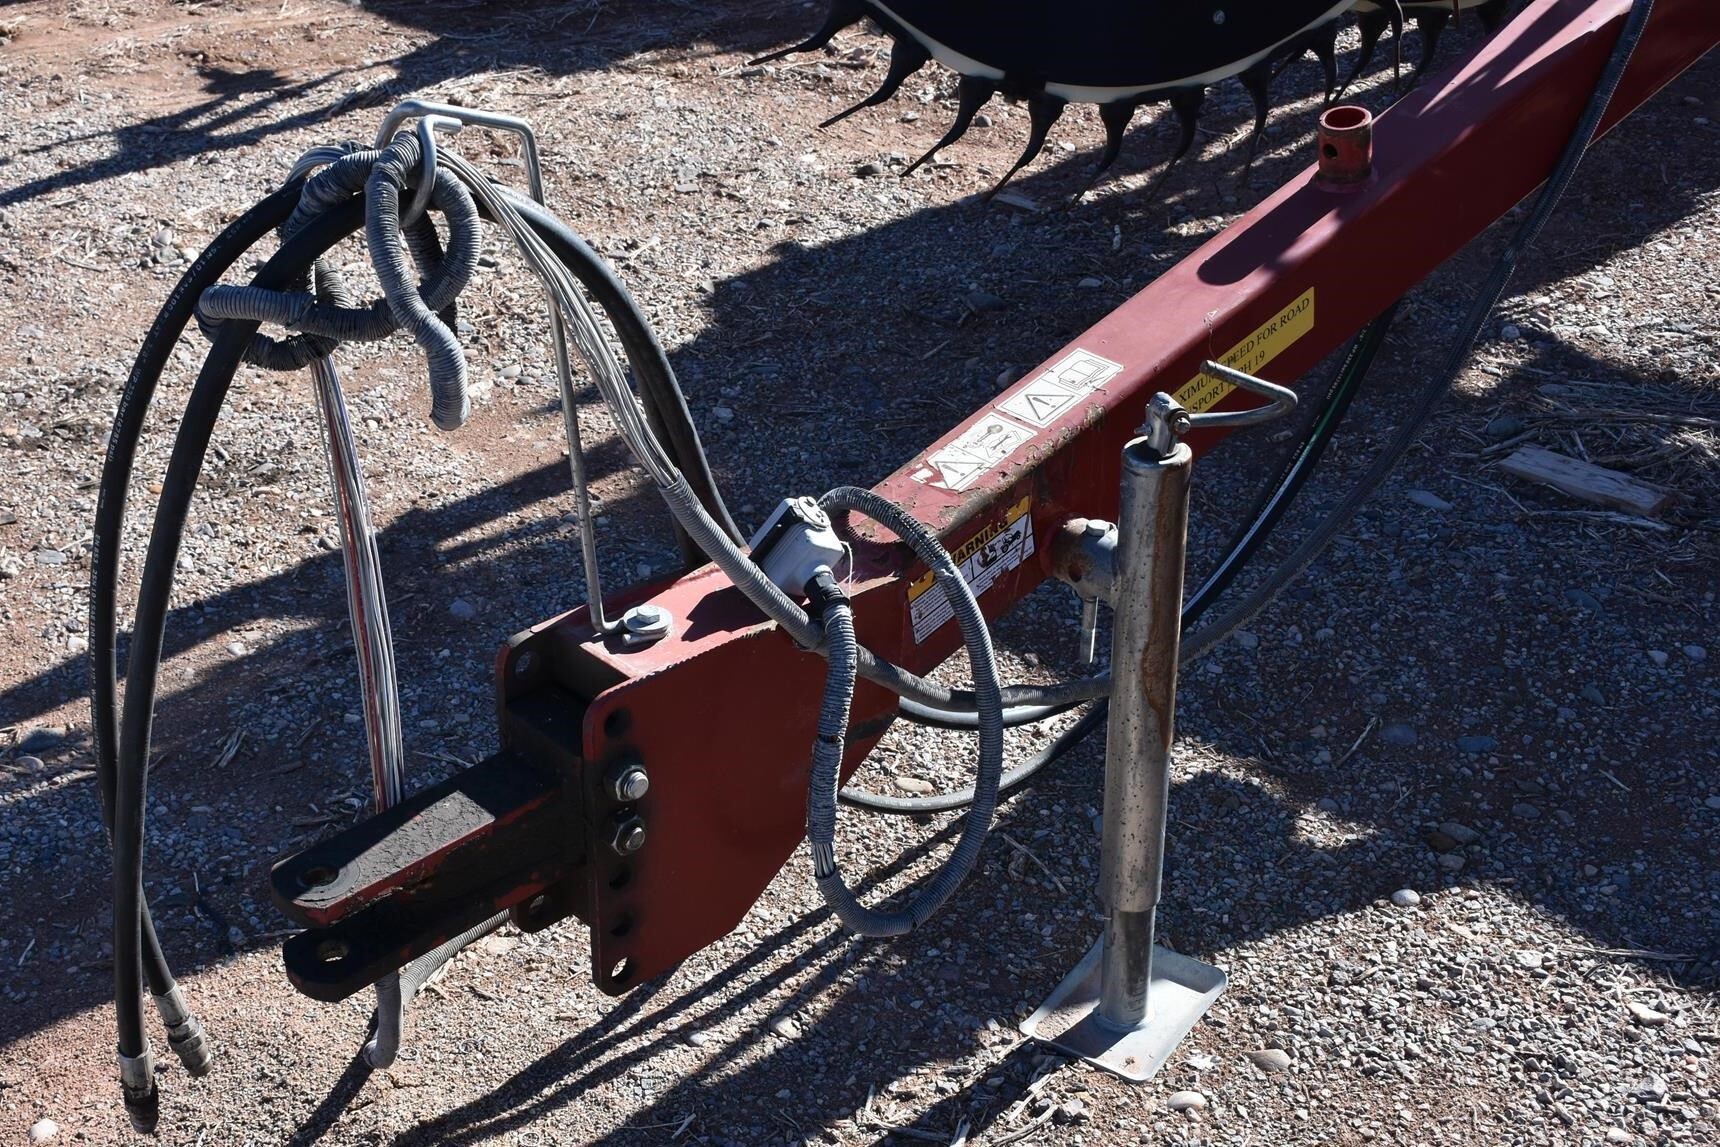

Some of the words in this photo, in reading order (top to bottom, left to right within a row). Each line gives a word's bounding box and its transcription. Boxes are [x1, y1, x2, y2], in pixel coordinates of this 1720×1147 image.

[1257, 323, 1278, 345] FOR
[1280, 298, 1310, 327] ROAD
[1189, 383, 1225, 413] SPORT
[1255, 351, 1265, 365] 19
